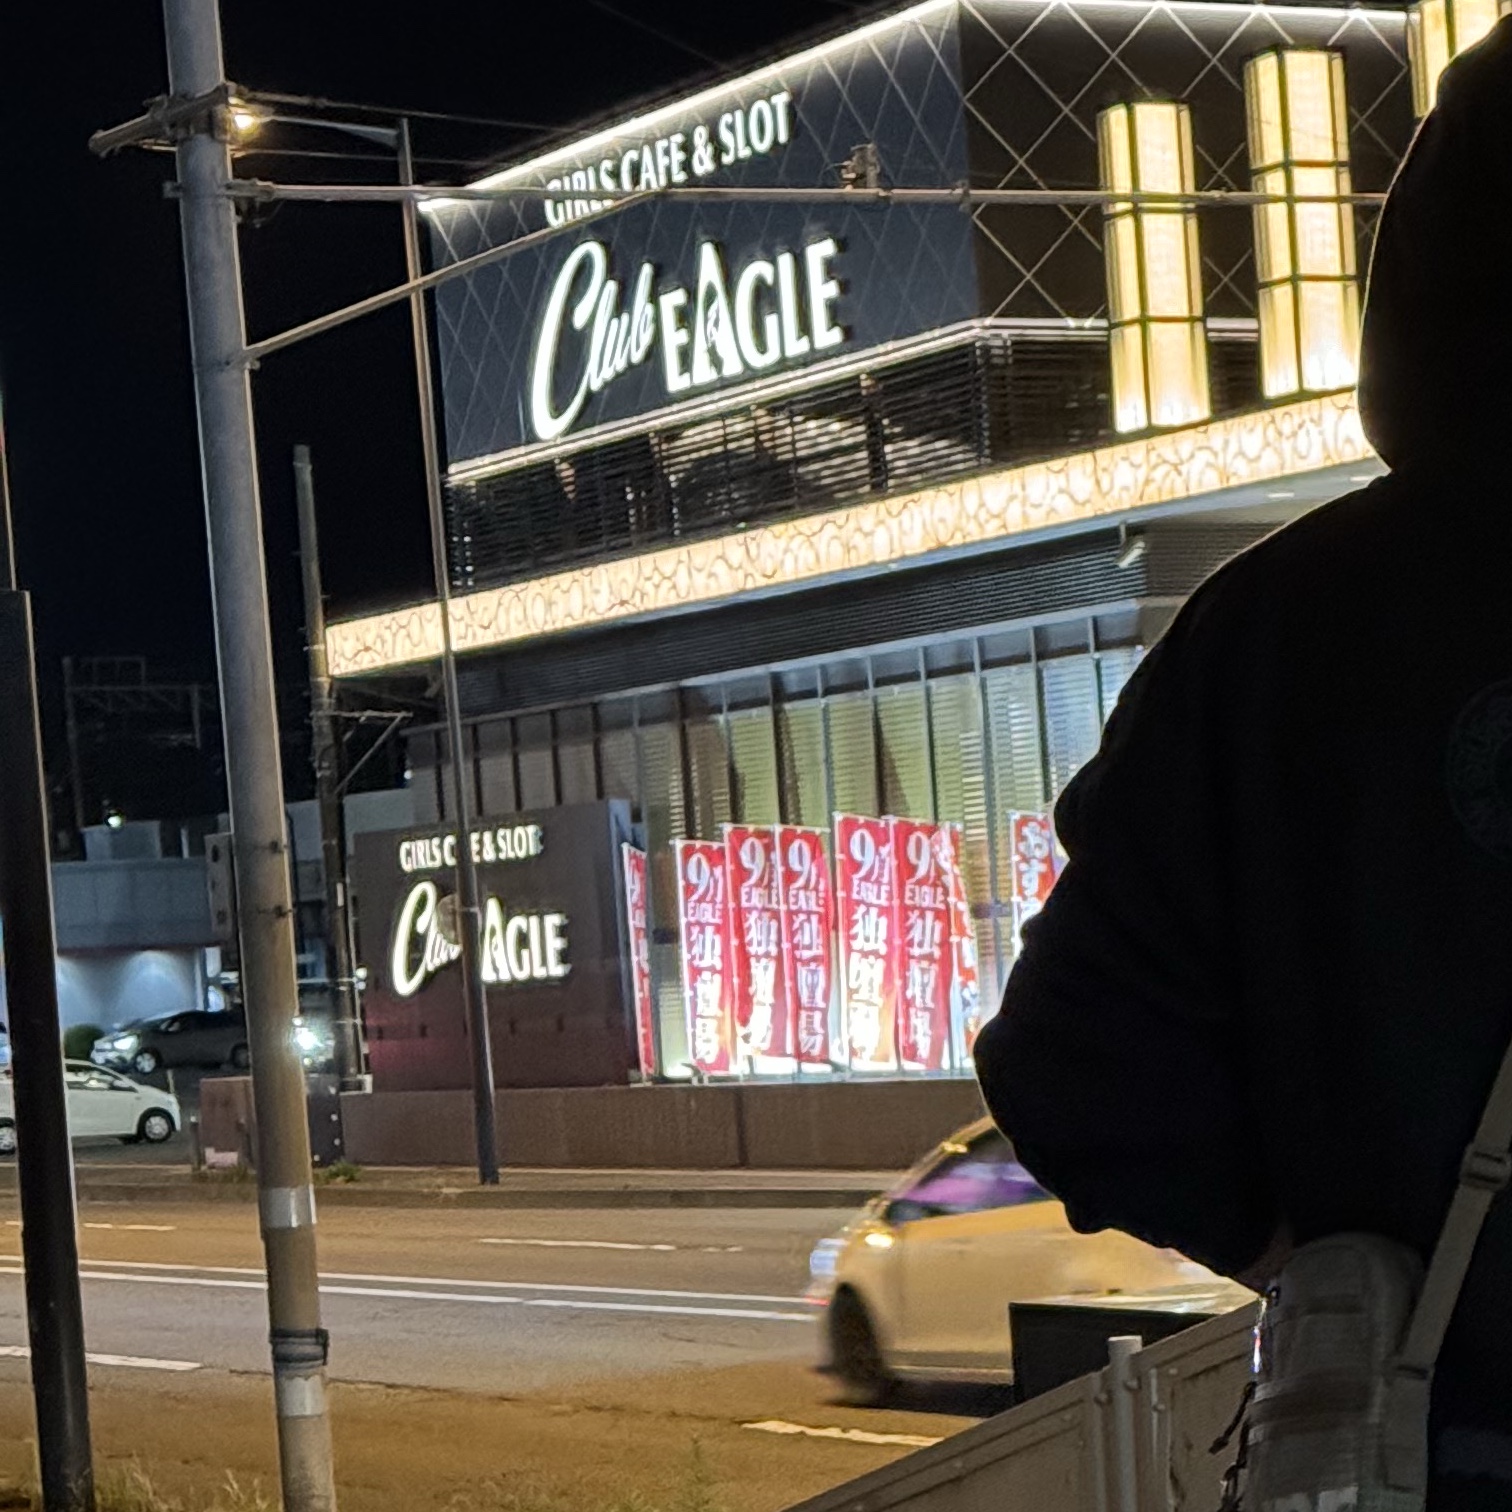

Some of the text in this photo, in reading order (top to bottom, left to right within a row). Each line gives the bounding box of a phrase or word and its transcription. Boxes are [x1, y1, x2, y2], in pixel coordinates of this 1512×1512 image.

[544, 90, 792, 228] GIRLS CAFE & SLOT
[531, 236, 845, 441] Club EAGLE
[399, 824, 543, 872] GIRLS CE & SLOT
[481, 896, 572, 983] AGLE
